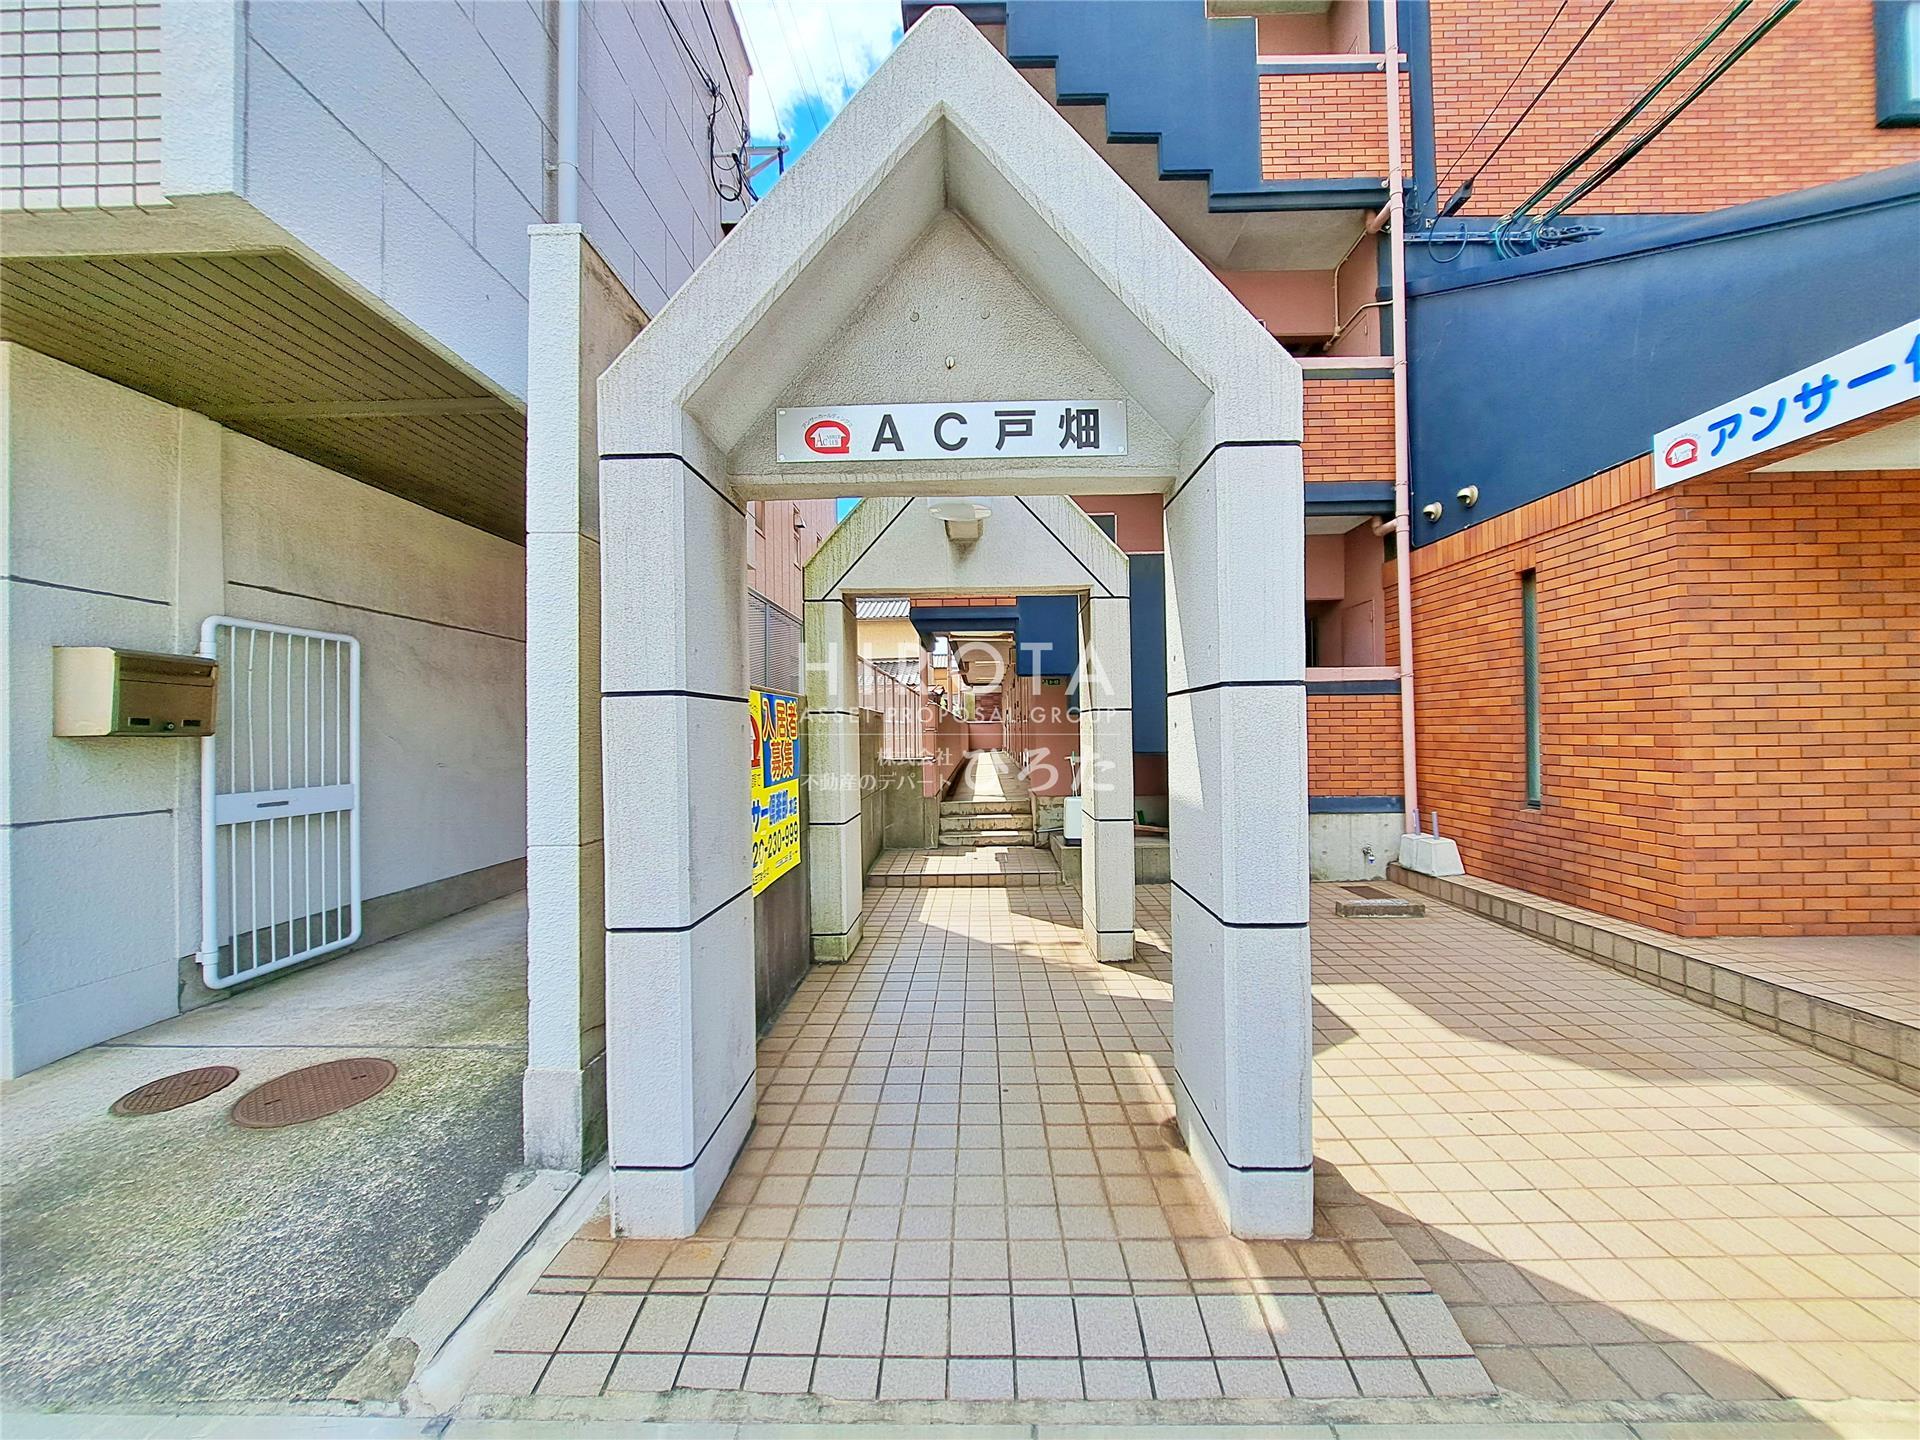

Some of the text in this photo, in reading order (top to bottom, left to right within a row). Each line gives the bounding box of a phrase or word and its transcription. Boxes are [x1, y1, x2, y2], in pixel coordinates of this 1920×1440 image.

[762, 698, 798, 741] 入居者
[770, 738, 794, 781] 募集
